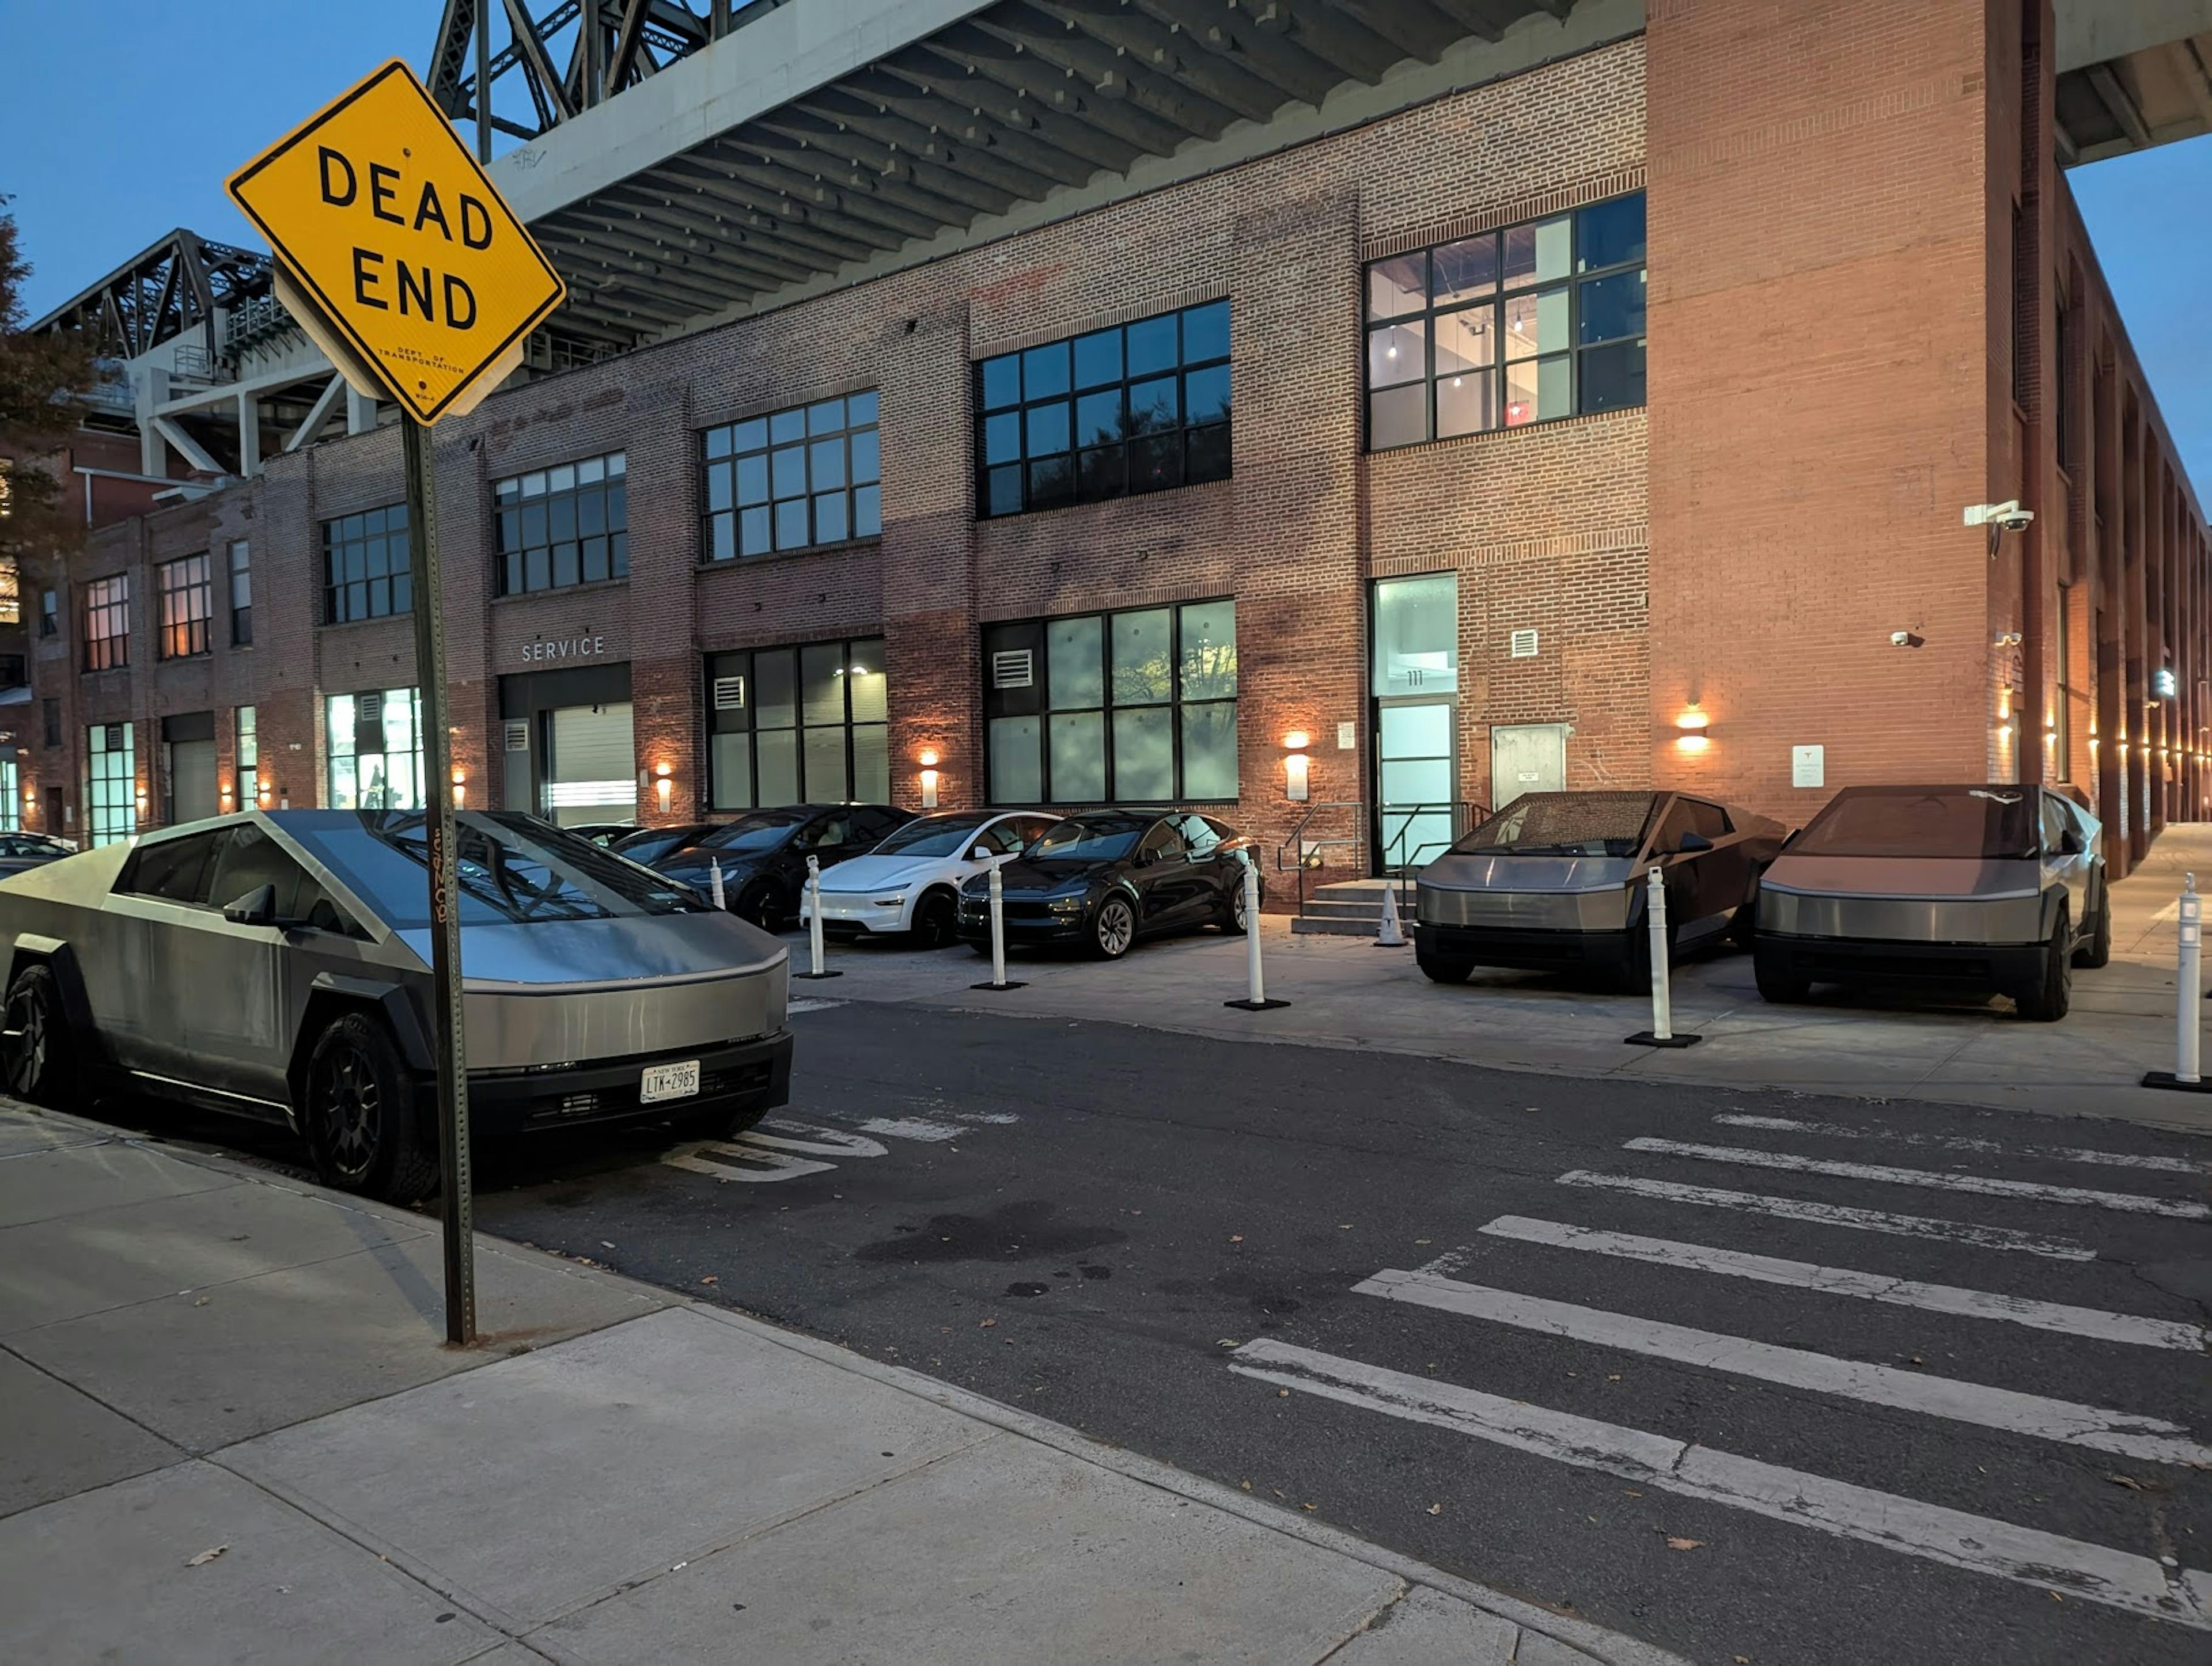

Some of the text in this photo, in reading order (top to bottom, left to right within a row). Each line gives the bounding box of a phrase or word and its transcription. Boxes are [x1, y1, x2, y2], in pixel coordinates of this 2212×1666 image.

[318, 145, 493, 251] DEAD
[353, 246, 477, 330] END
[378, 348, 464, 374] TRANSPORTATION
[397, 347, 422, 358] DEPT
[522, 636, 604, 662] SERVICE
[1407, 670, 1423, 686] 111
